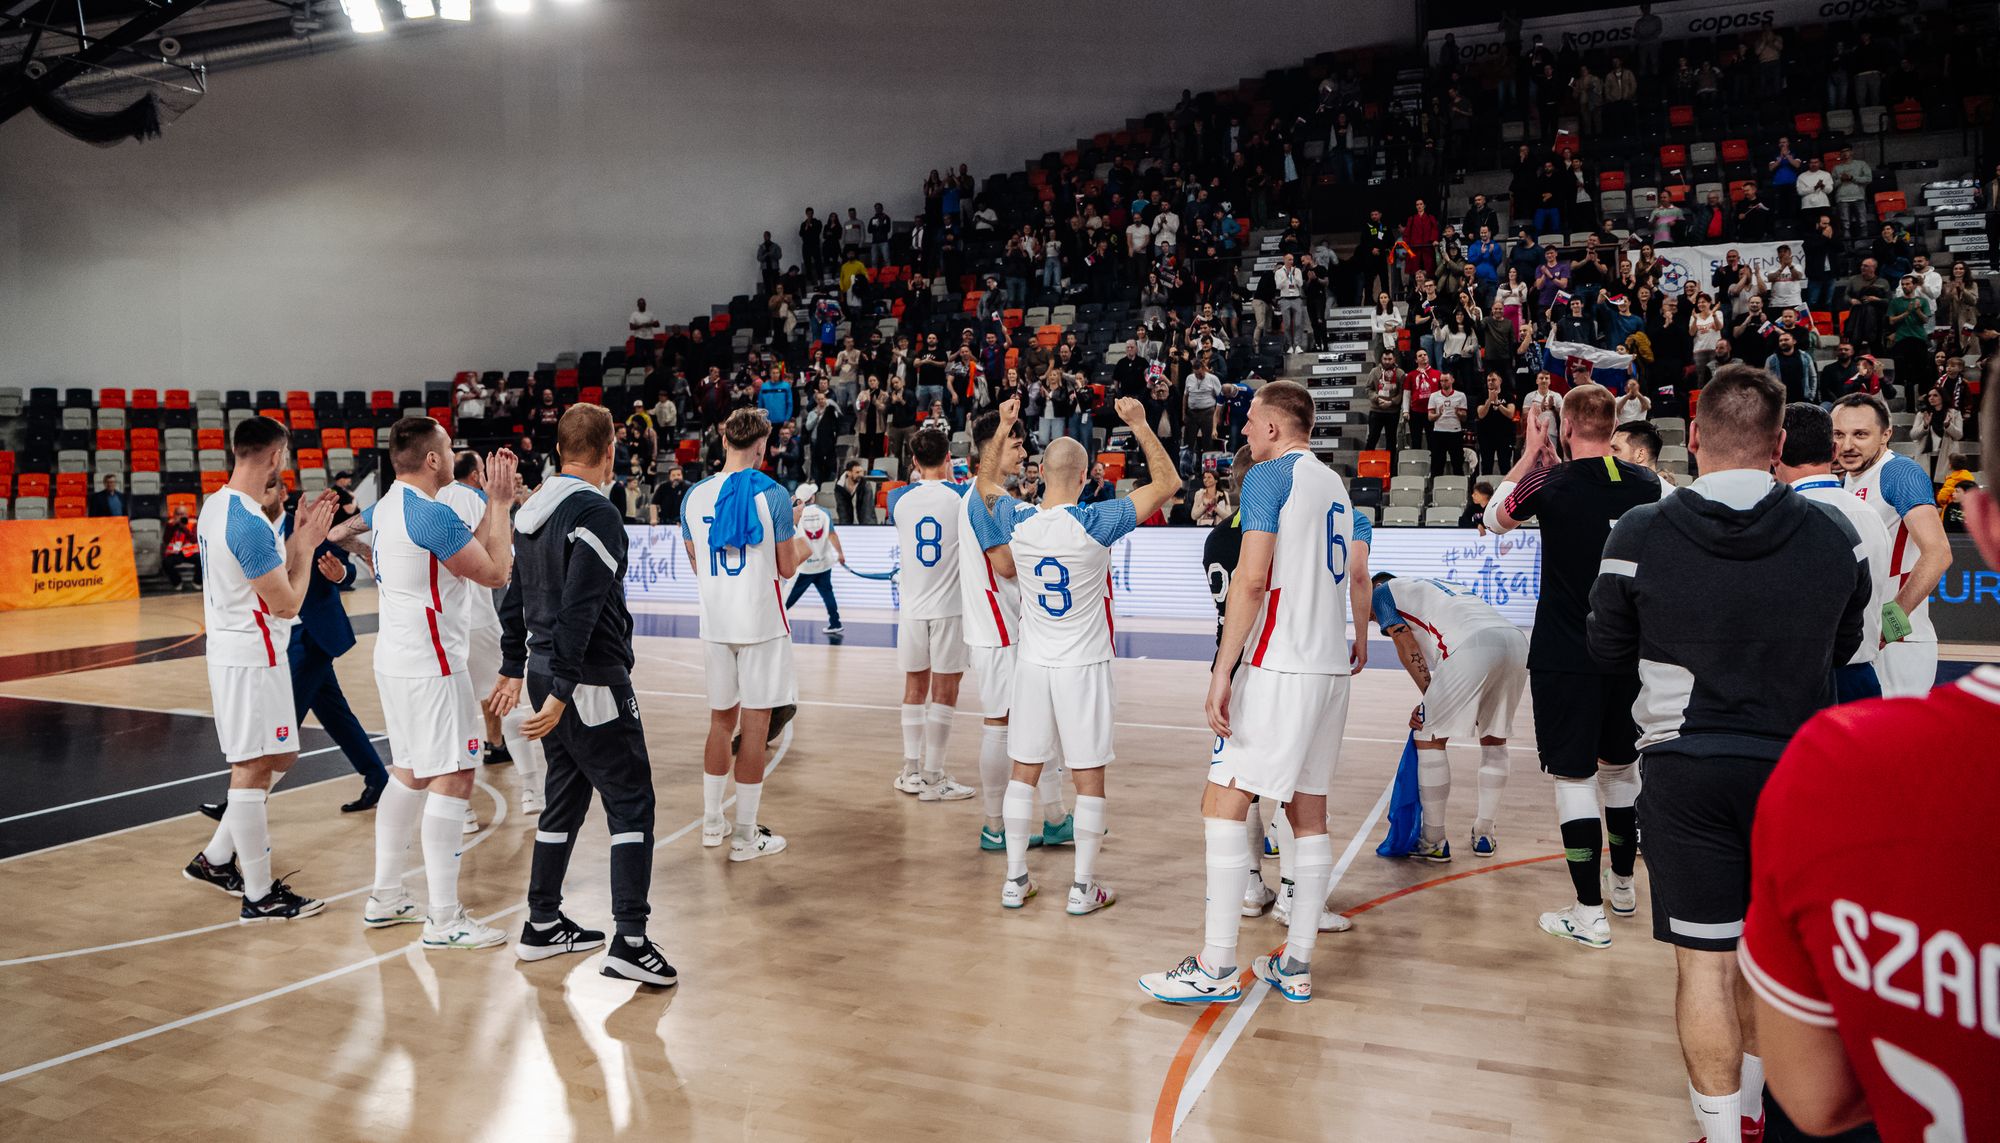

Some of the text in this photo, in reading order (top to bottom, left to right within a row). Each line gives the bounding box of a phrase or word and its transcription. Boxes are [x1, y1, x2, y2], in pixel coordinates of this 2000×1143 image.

[31, 534, 102, 574] niké
[915, 516, 942, 567] 8
[1326, 501, 1347, 585] 6
[33, 578, 45, 594] je
[1034, 556, 1073, 617] 3
[1928, 570, 2000, 604] UR
